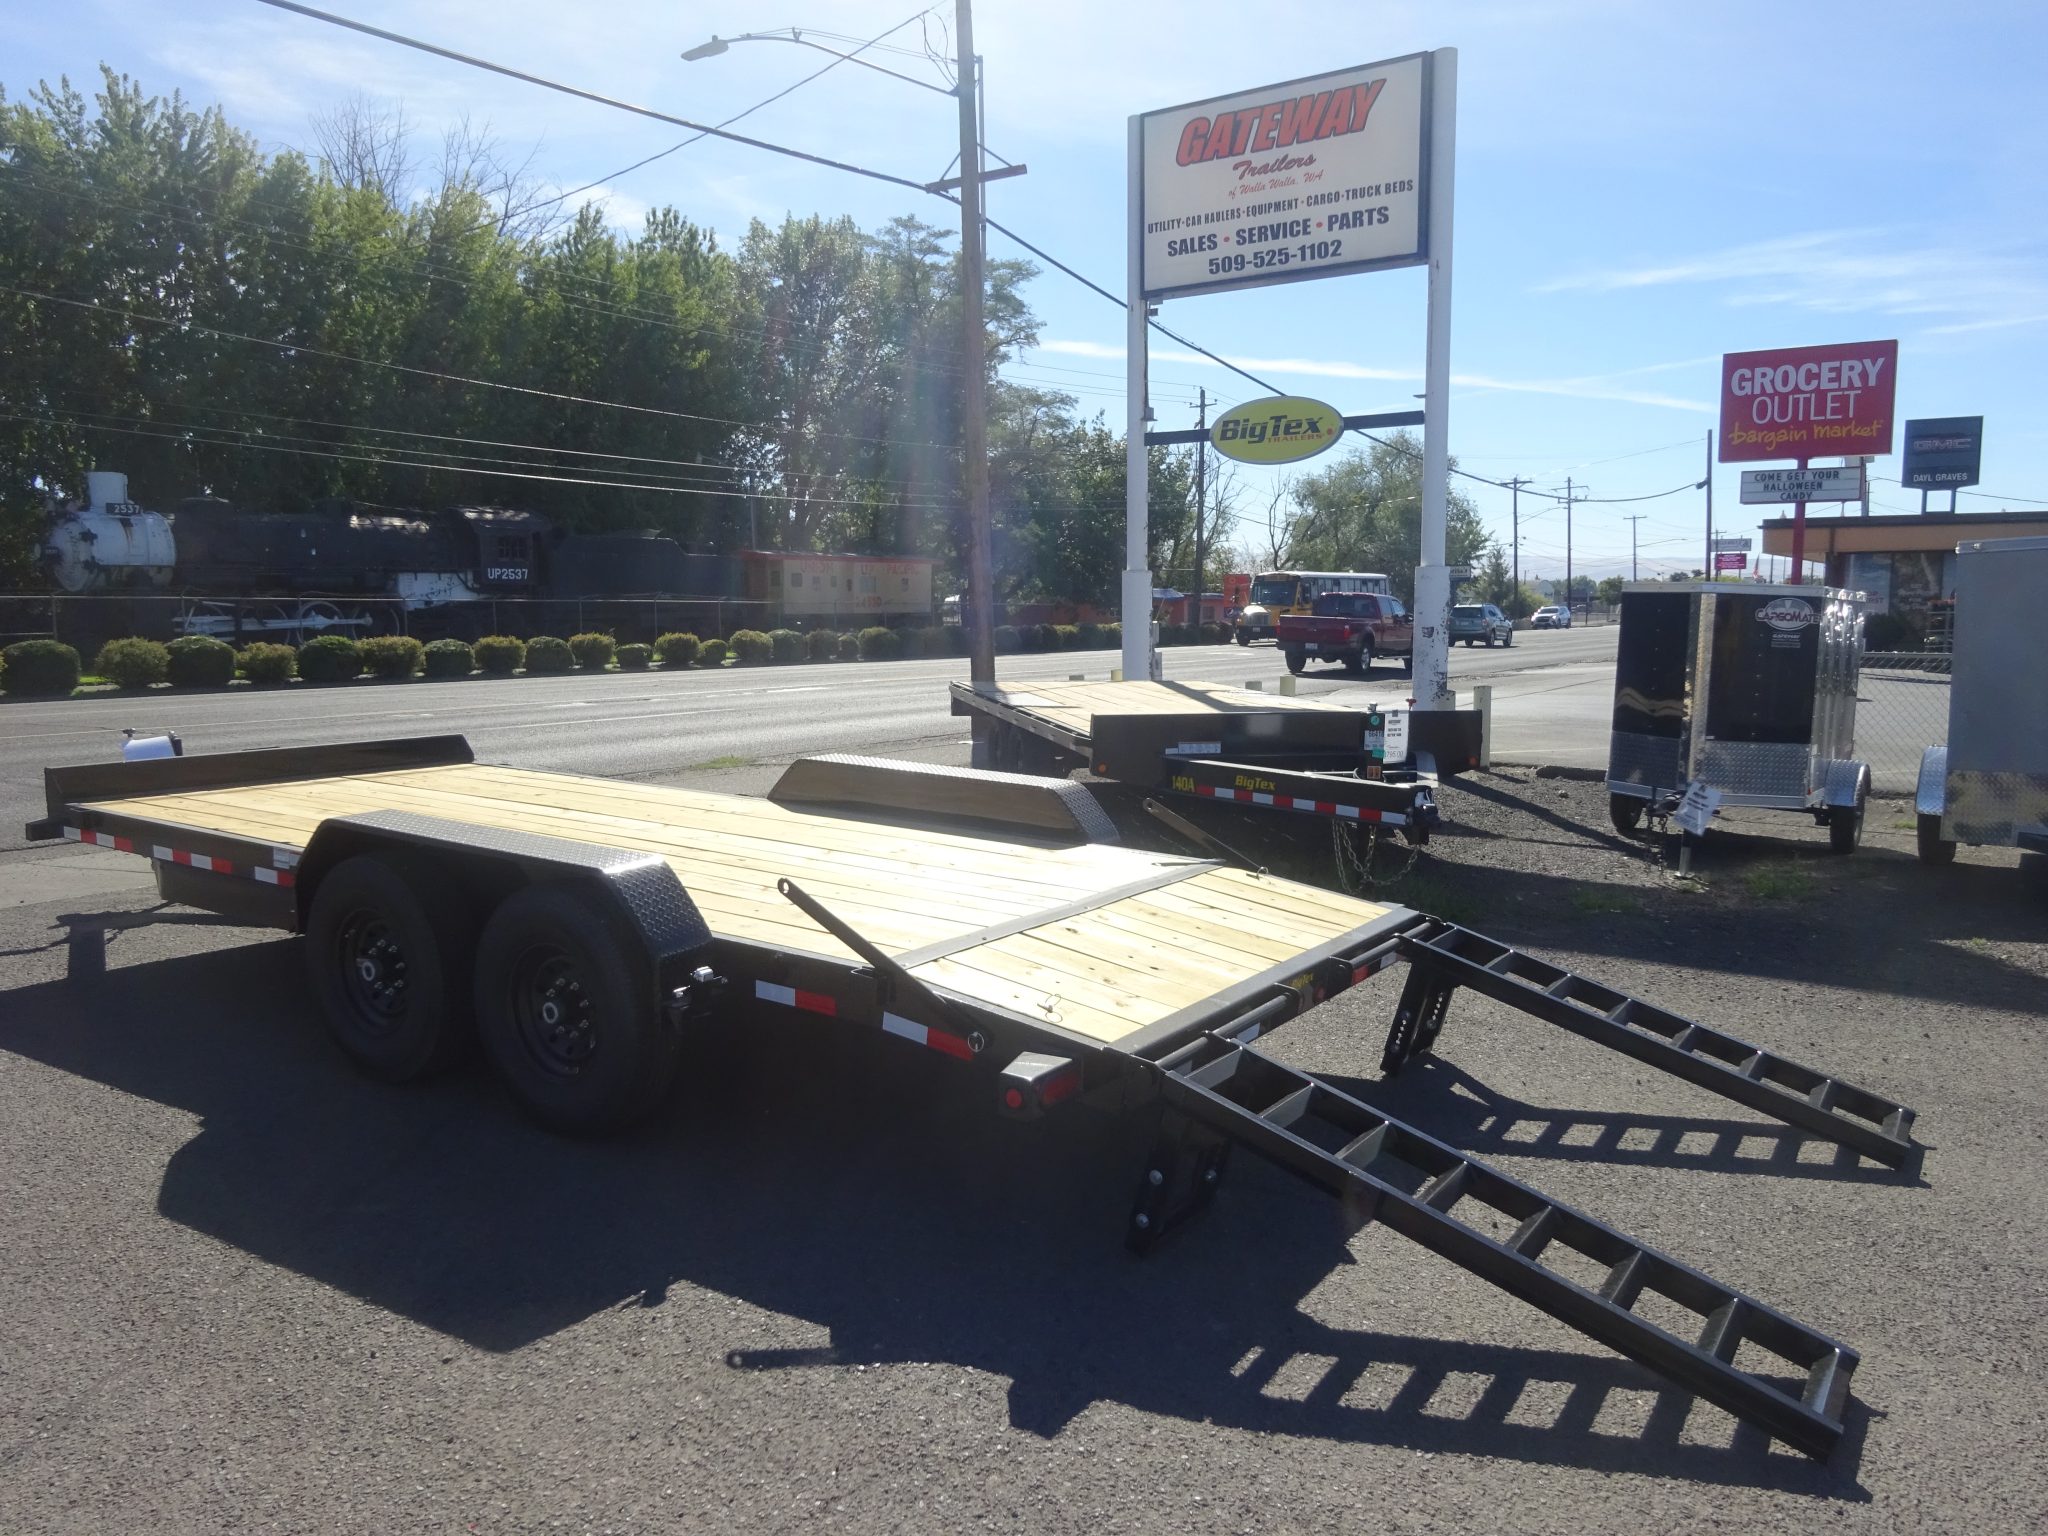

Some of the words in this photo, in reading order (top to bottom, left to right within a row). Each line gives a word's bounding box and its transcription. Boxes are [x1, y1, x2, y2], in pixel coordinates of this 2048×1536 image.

[1175, 78, 1387, 167] GATEWAY
[1232, 153, 1317, 180] Trailers
[1204, 207, 1241, 224] HAULERS
[1306, 191, 1340, 207] CARGO
[1384, 179, 1414, 195] BEDS
[1167, 233, 1218, 257] SALES
[1235, 218, 1312, 246] SERVICE
[1327, 206, 1390, 232] PARTS
[1208, 239, 1342, 275] 509-525-1102
[1731, 357, 1886, 397] GROCERY
[1752, 390, 1862, 425] OUTLET
[1220, 414, 1323, 444] BigTex
[1728, 422, 1807, 451] bargain
[1814, 420, 1882, 440] market
[1913, 438, 1972, 450] GMC
[1754, 472, 1782, 482] COME
[1787, 471, 1807, 481] GET
[1812, 470, 1840, 480] YOUR
[1763, 481, 1823, 491] HALLOWEEN
[1913, 474, 1933, 482] DAYL
[1935, 472, 1968, 482] GRAVES
[114, 504, 140, 513] 2537
[1780, 491, 1813, 501] CANDY
[487, 567, 528, 580] UP2537
[1234, 774, 1277, 792] BigTex
